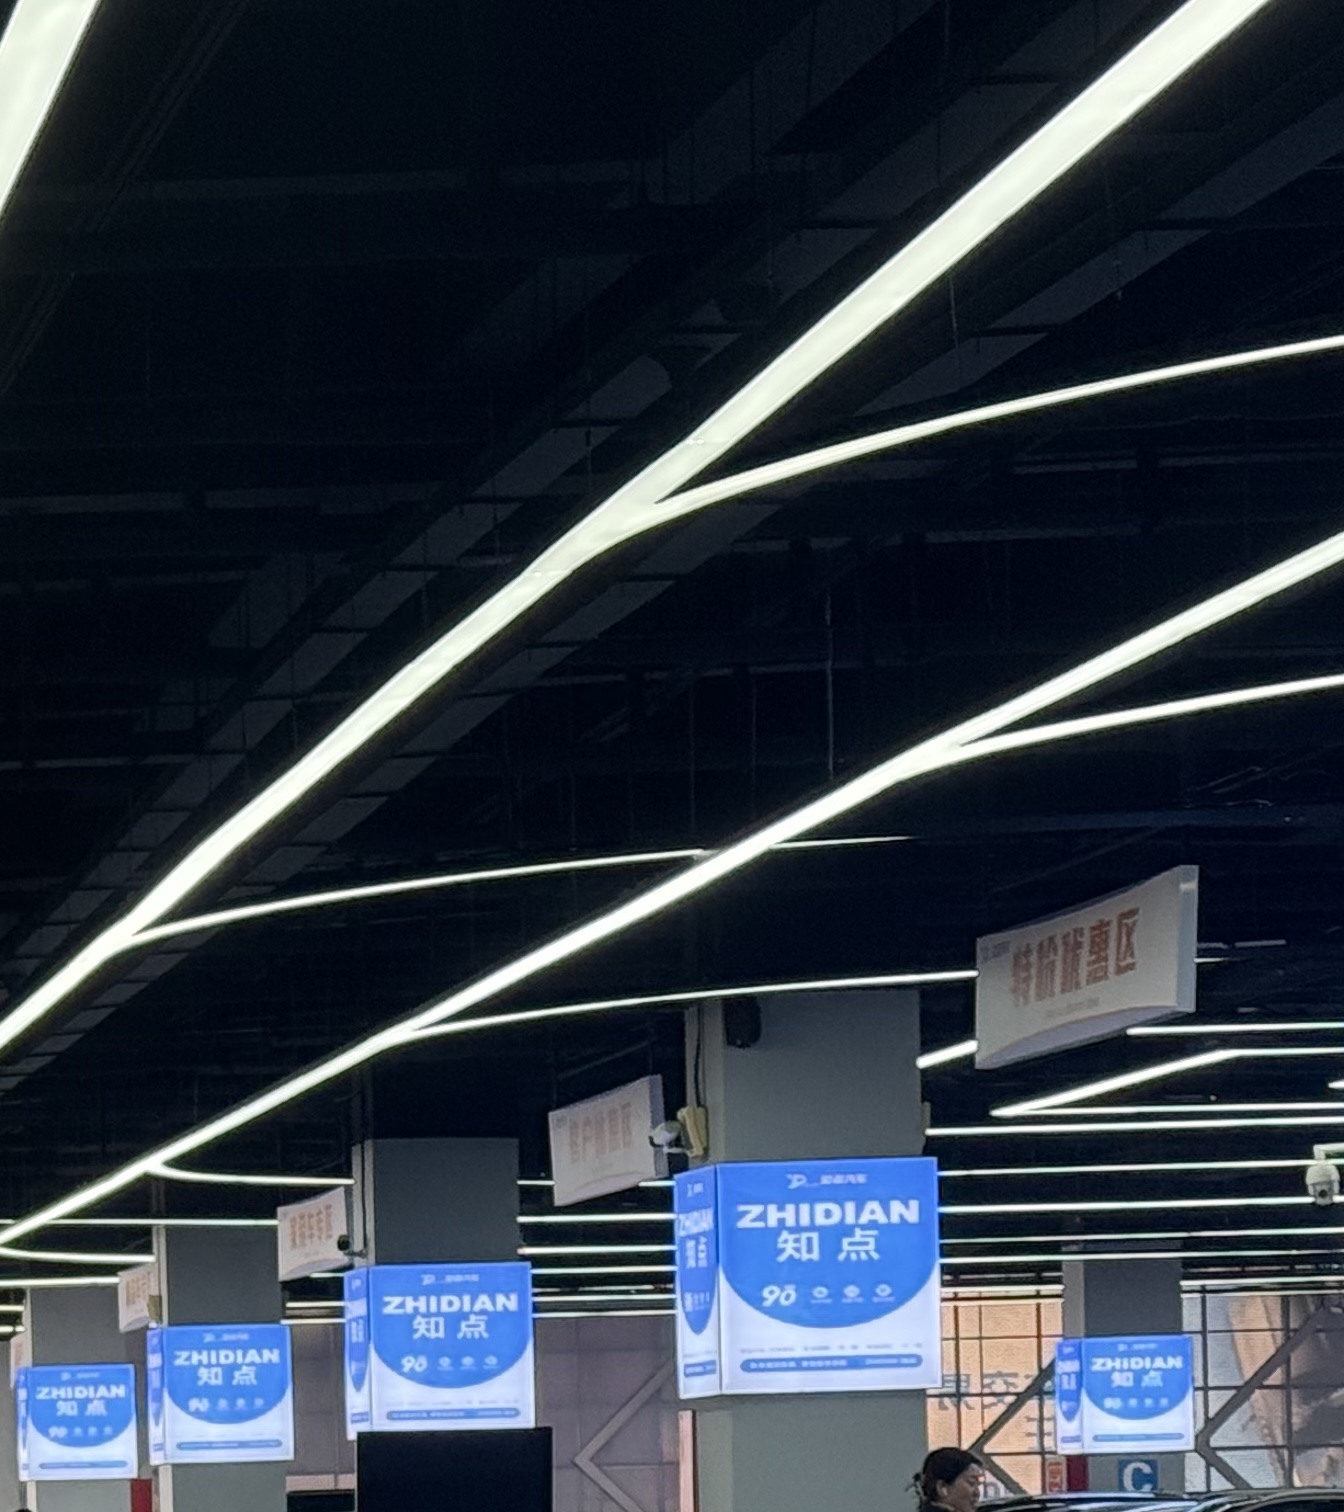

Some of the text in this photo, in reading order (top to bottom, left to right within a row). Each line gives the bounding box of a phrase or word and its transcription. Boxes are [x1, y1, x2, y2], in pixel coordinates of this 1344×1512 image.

[736, 1199, 920, 1229] ZHIDIAN
[776, 1228, 880, 1262] 知点
[382, 1292, 519, 1315] ZHIDIAN
[413, 1314, 489, 1340] 知点
[174, 1348, 280, 1366] ZHIDIAN
[1091, 1356, 1183, 1372] ZHIDIAN
[35, 1384, 126, 1400] ZHIDIAN
[1123, 1462, 1153, 1491] C
